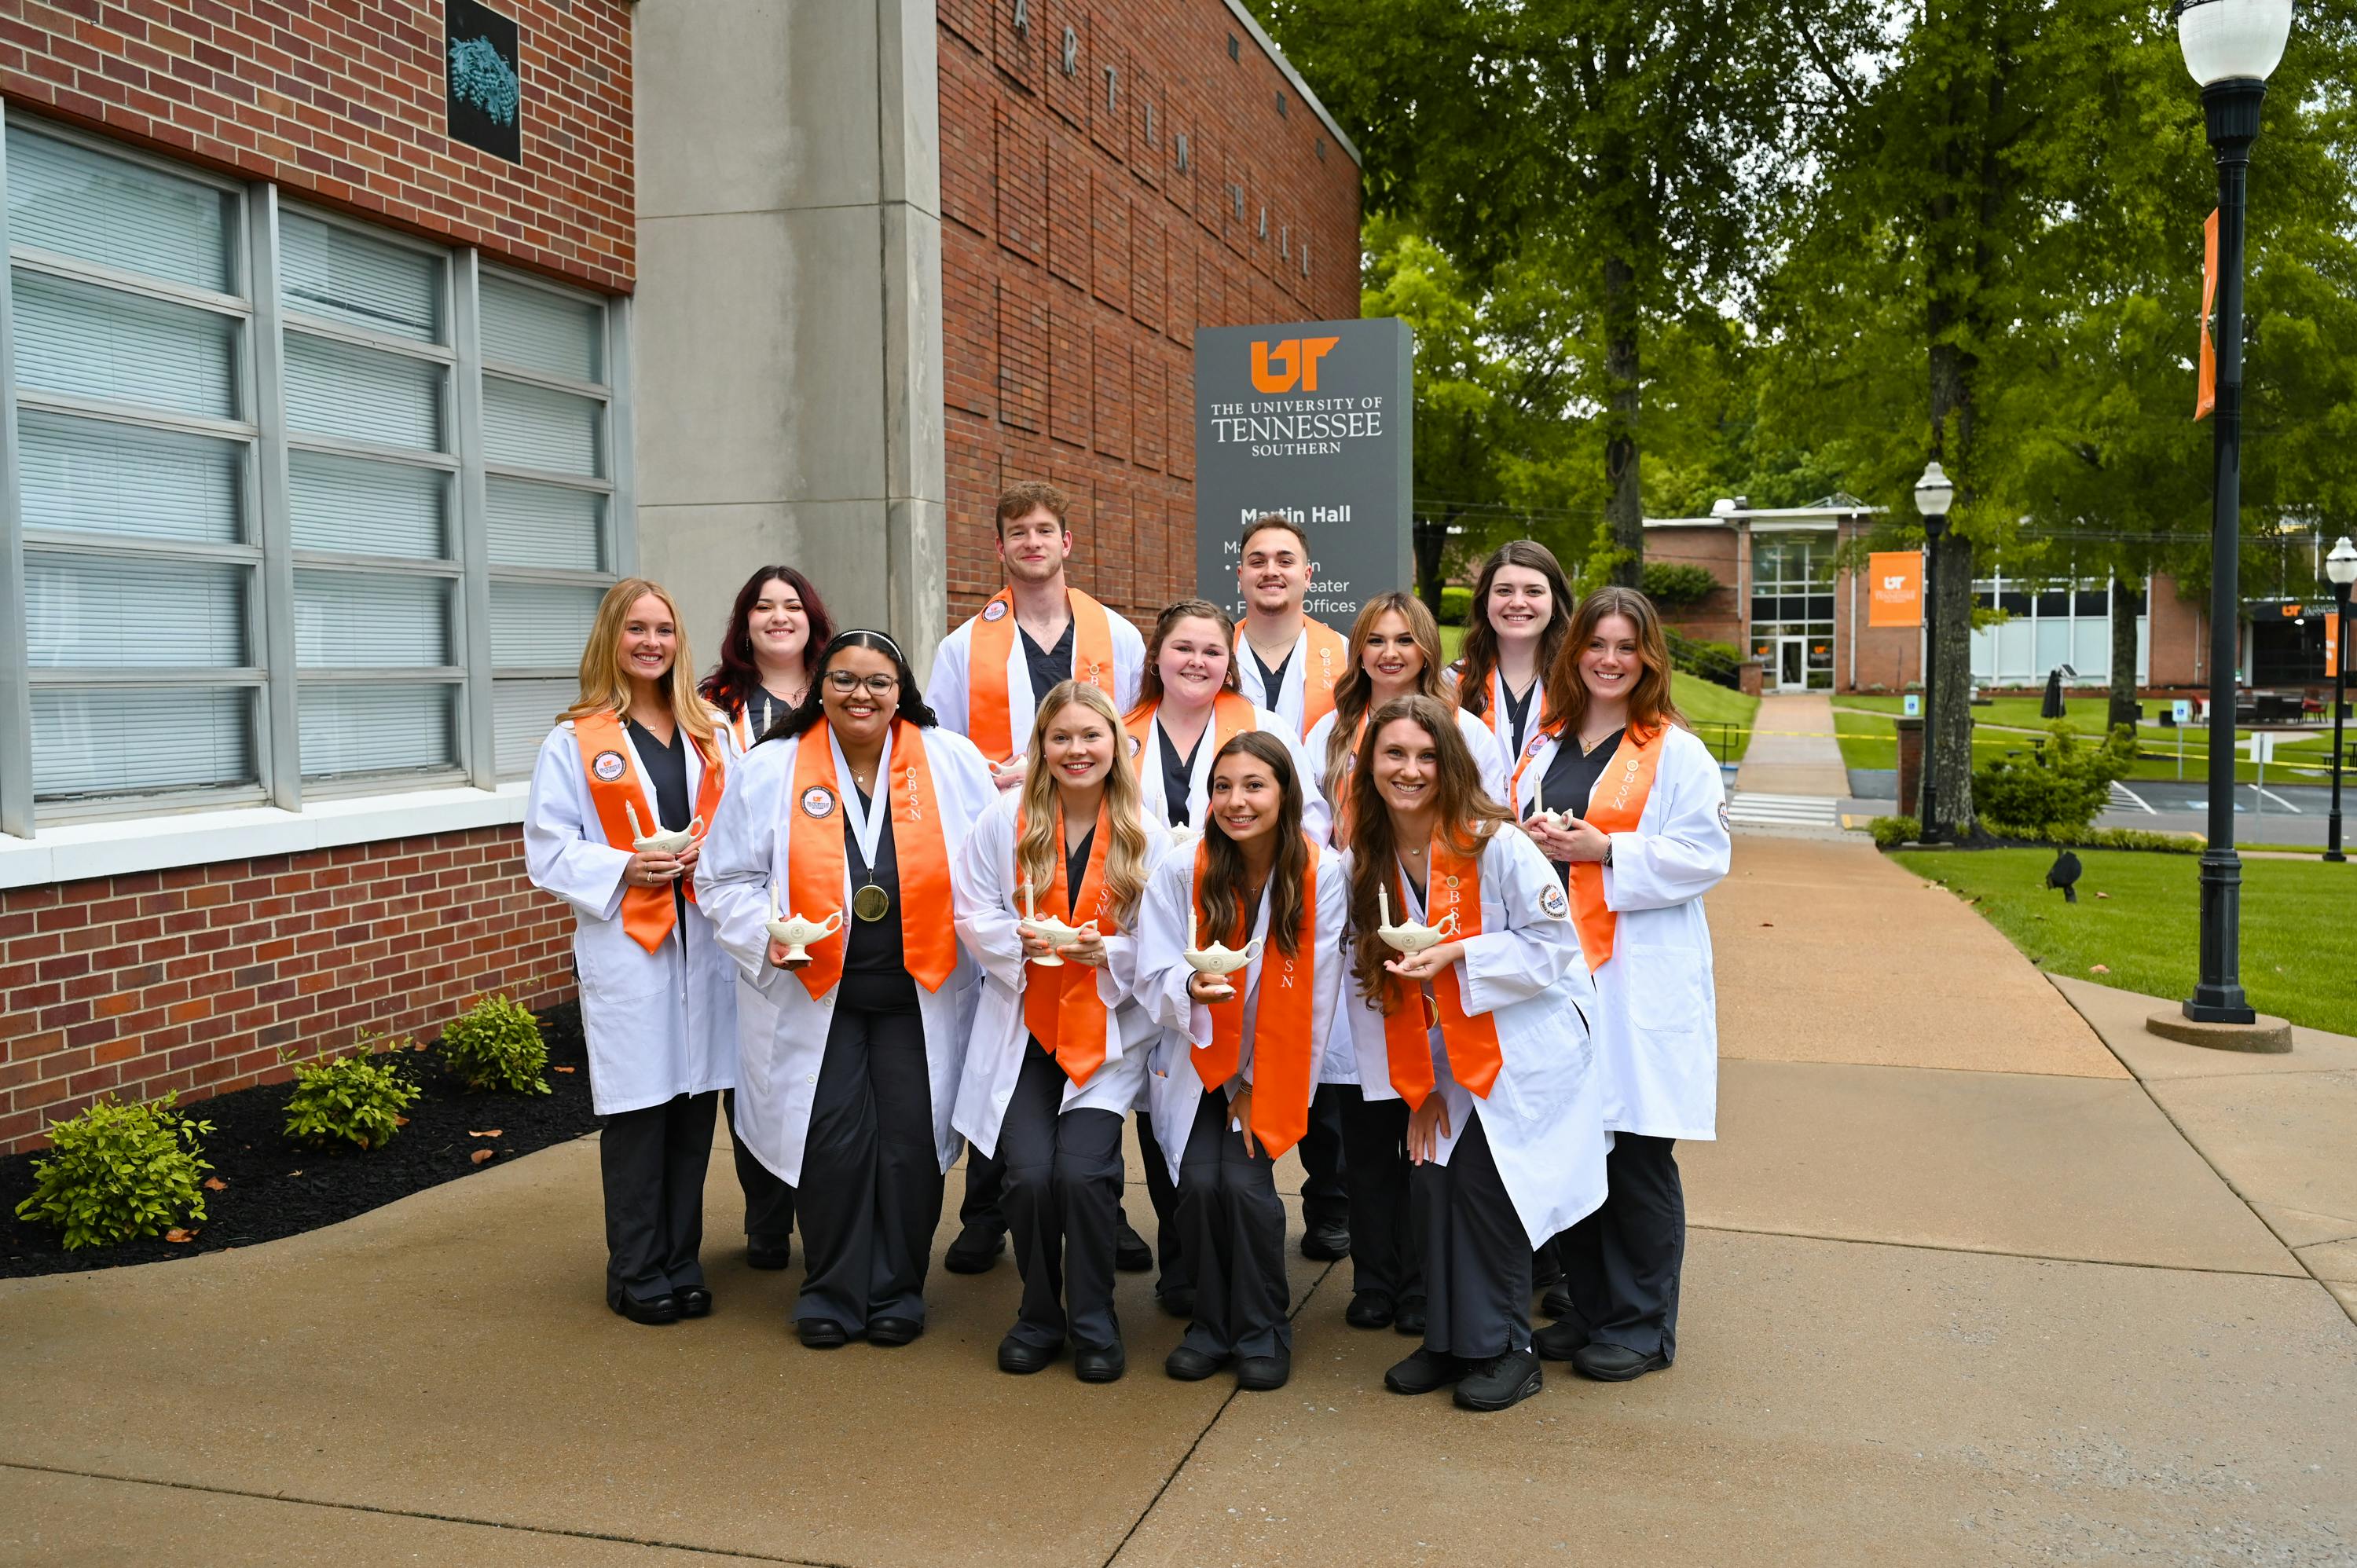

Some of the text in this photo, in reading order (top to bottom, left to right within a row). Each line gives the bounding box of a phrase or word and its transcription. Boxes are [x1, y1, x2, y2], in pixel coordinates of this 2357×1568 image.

[1250, 336, 1340, 394] UT
[1211, 396, 1383, 416] THE UNIVERSITY OF
[1211, 412, 1383, 442] TENNESSEE
[1252, 441, 1342, 457] SOUTHERN
[1312, 505, 1351, 522] Hall
[1309, 580, 1350, 592] eater
[1302, 599, 1357, 613] Offices
